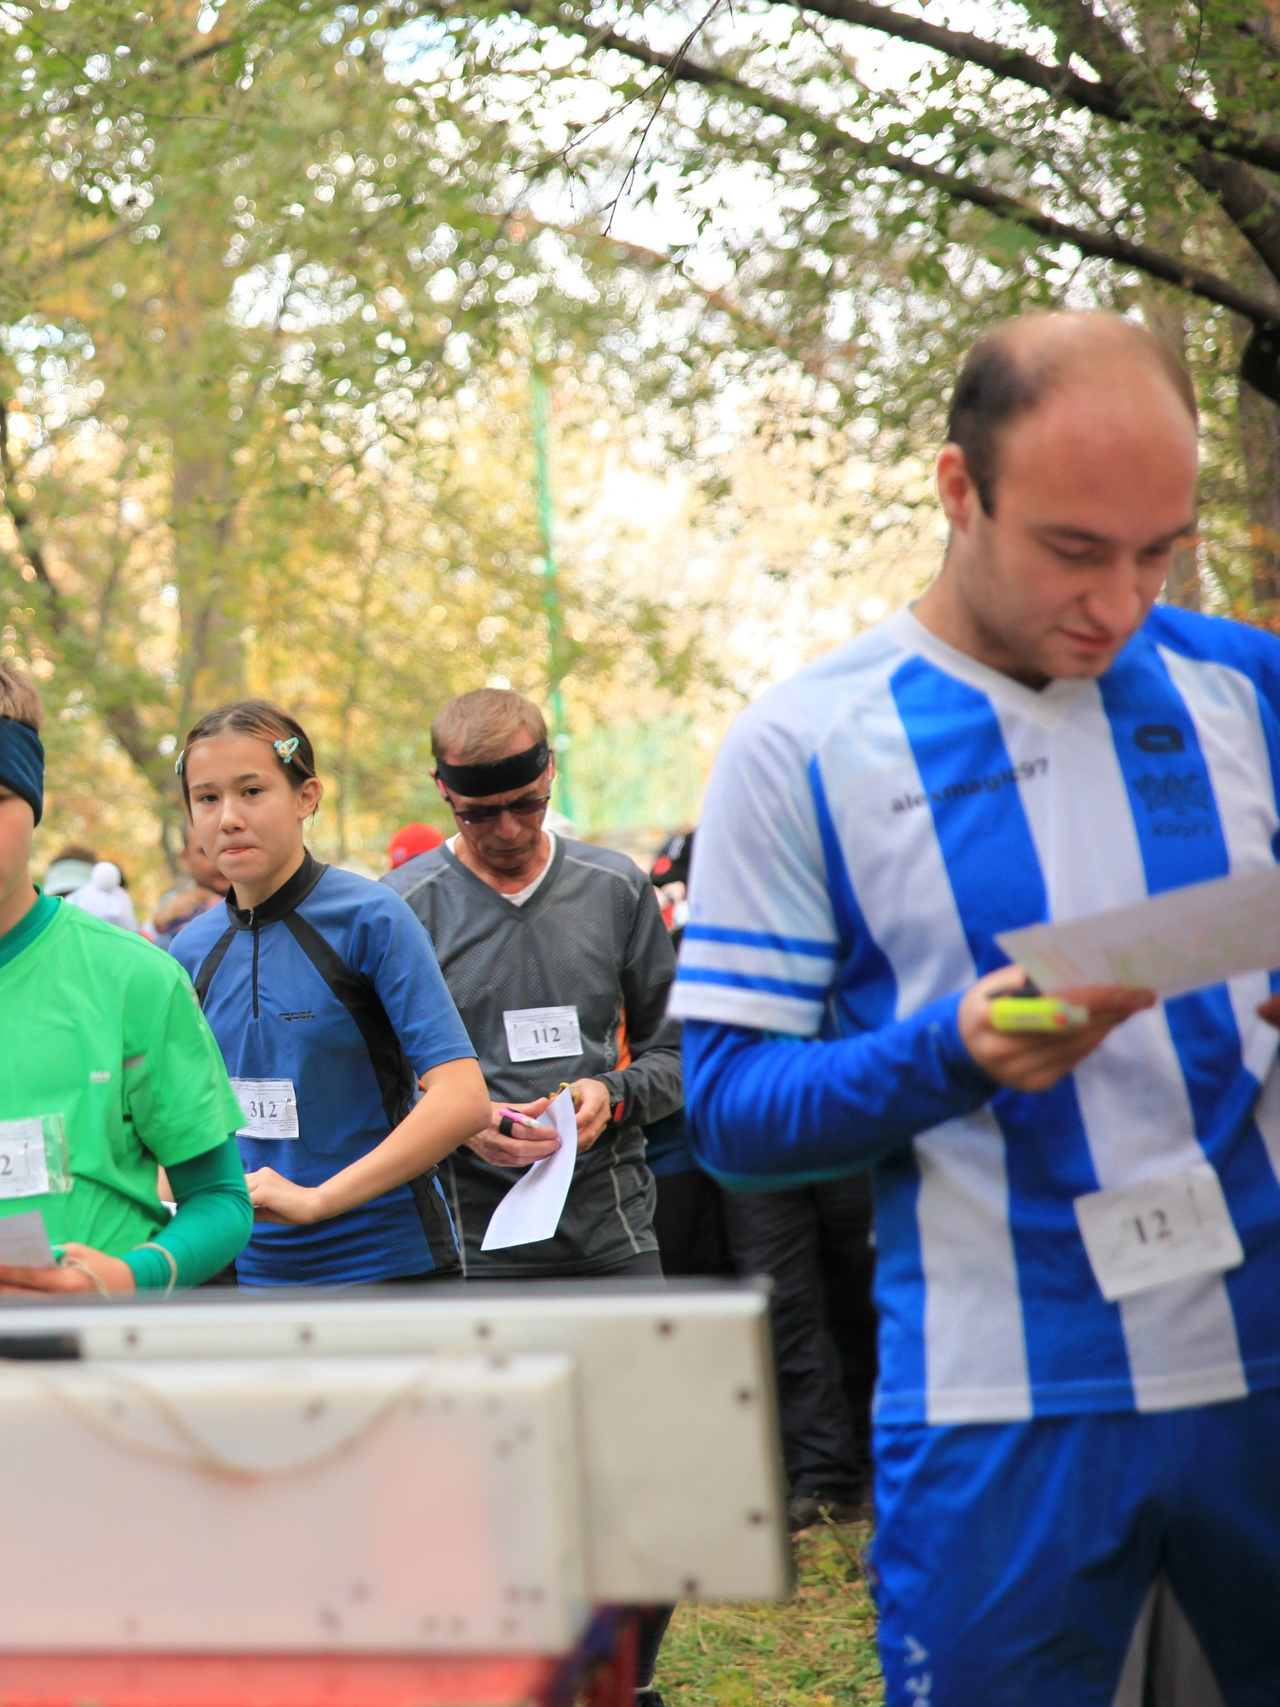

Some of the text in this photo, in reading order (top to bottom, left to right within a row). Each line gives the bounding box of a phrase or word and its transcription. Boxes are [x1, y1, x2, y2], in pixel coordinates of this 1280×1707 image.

[532, 1027, 562, 1044] 112
[249, 1101, 278, 1118] 312
[1133, 1208, 1172, 1244] 12
